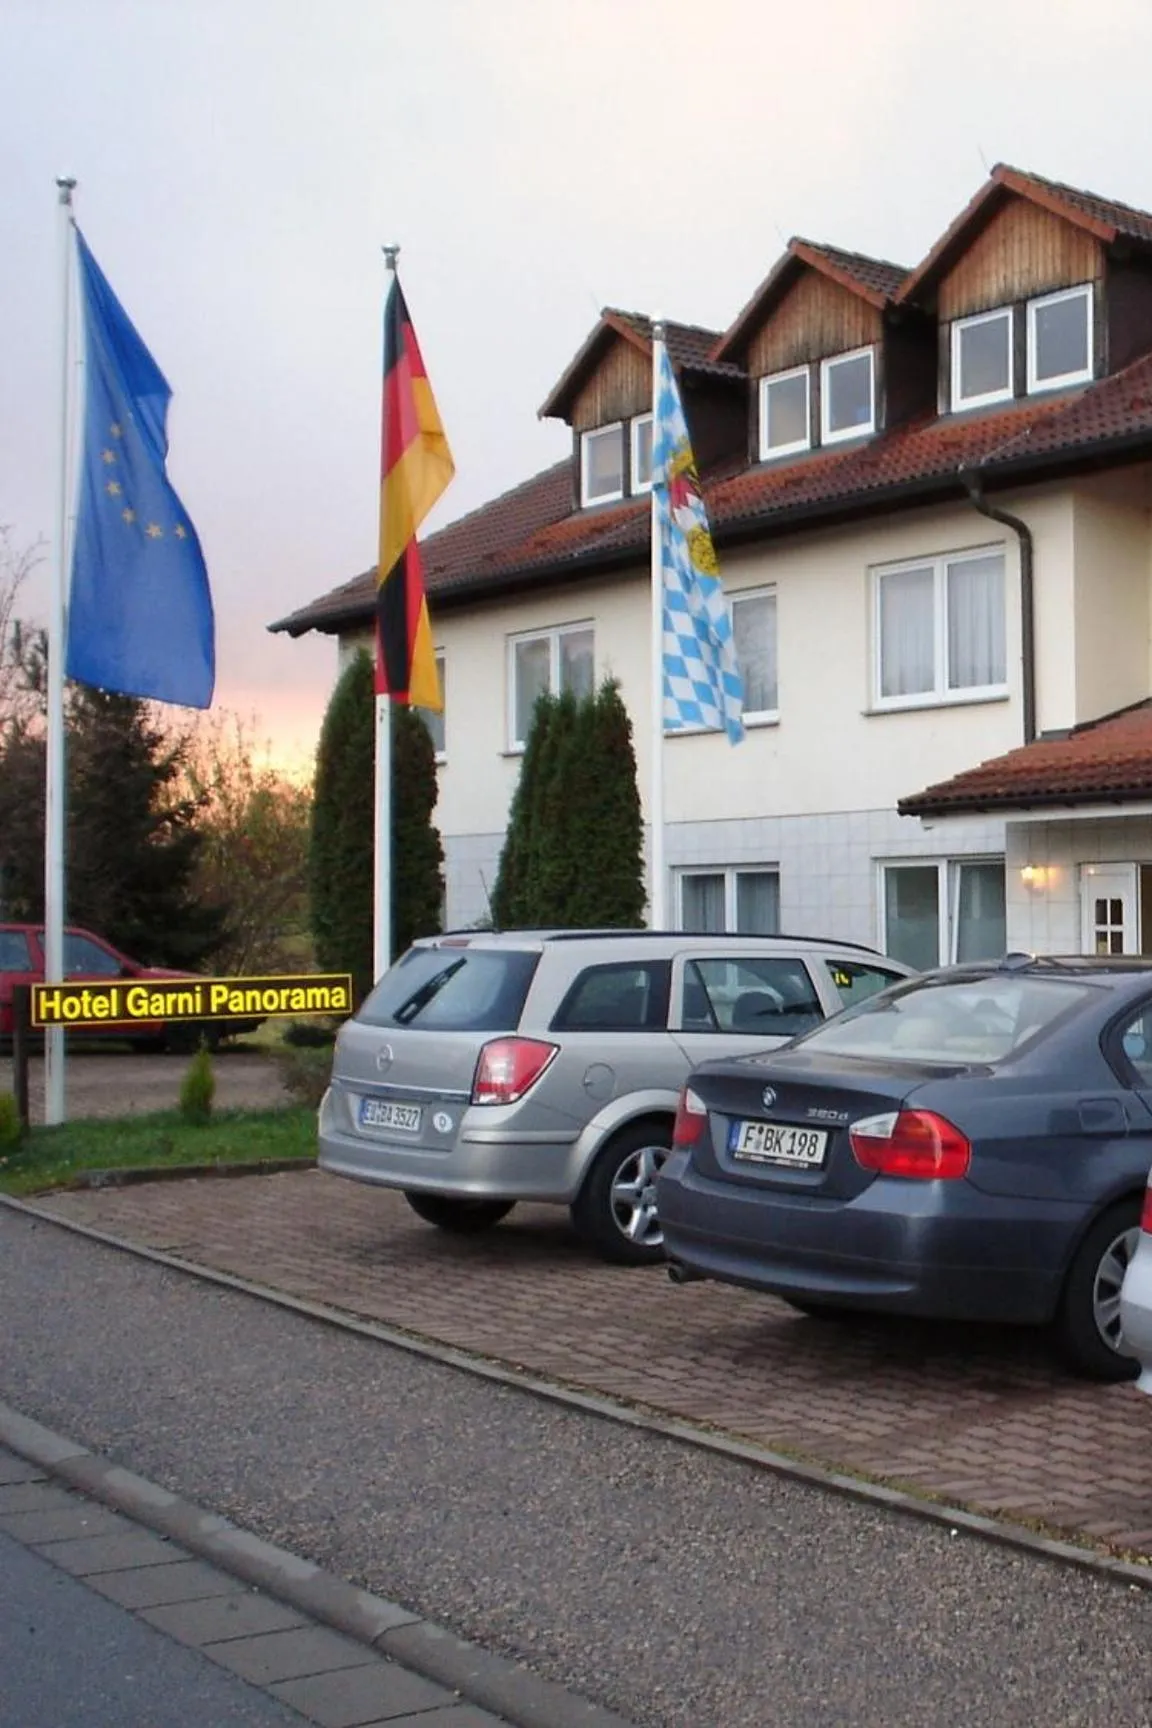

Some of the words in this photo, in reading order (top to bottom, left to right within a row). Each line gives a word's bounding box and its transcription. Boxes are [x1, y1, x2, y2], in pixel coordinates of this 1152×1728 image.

[39, 988, 118, 1020] Hotel
[126, 985, 202, 1017] Garni
[210, 983, 346, 1013] Panorama
[743, 1126, 755, 1149] F
[763, 1128, 785, 1153] BK
[786, 1131, 818, 1157] 198
